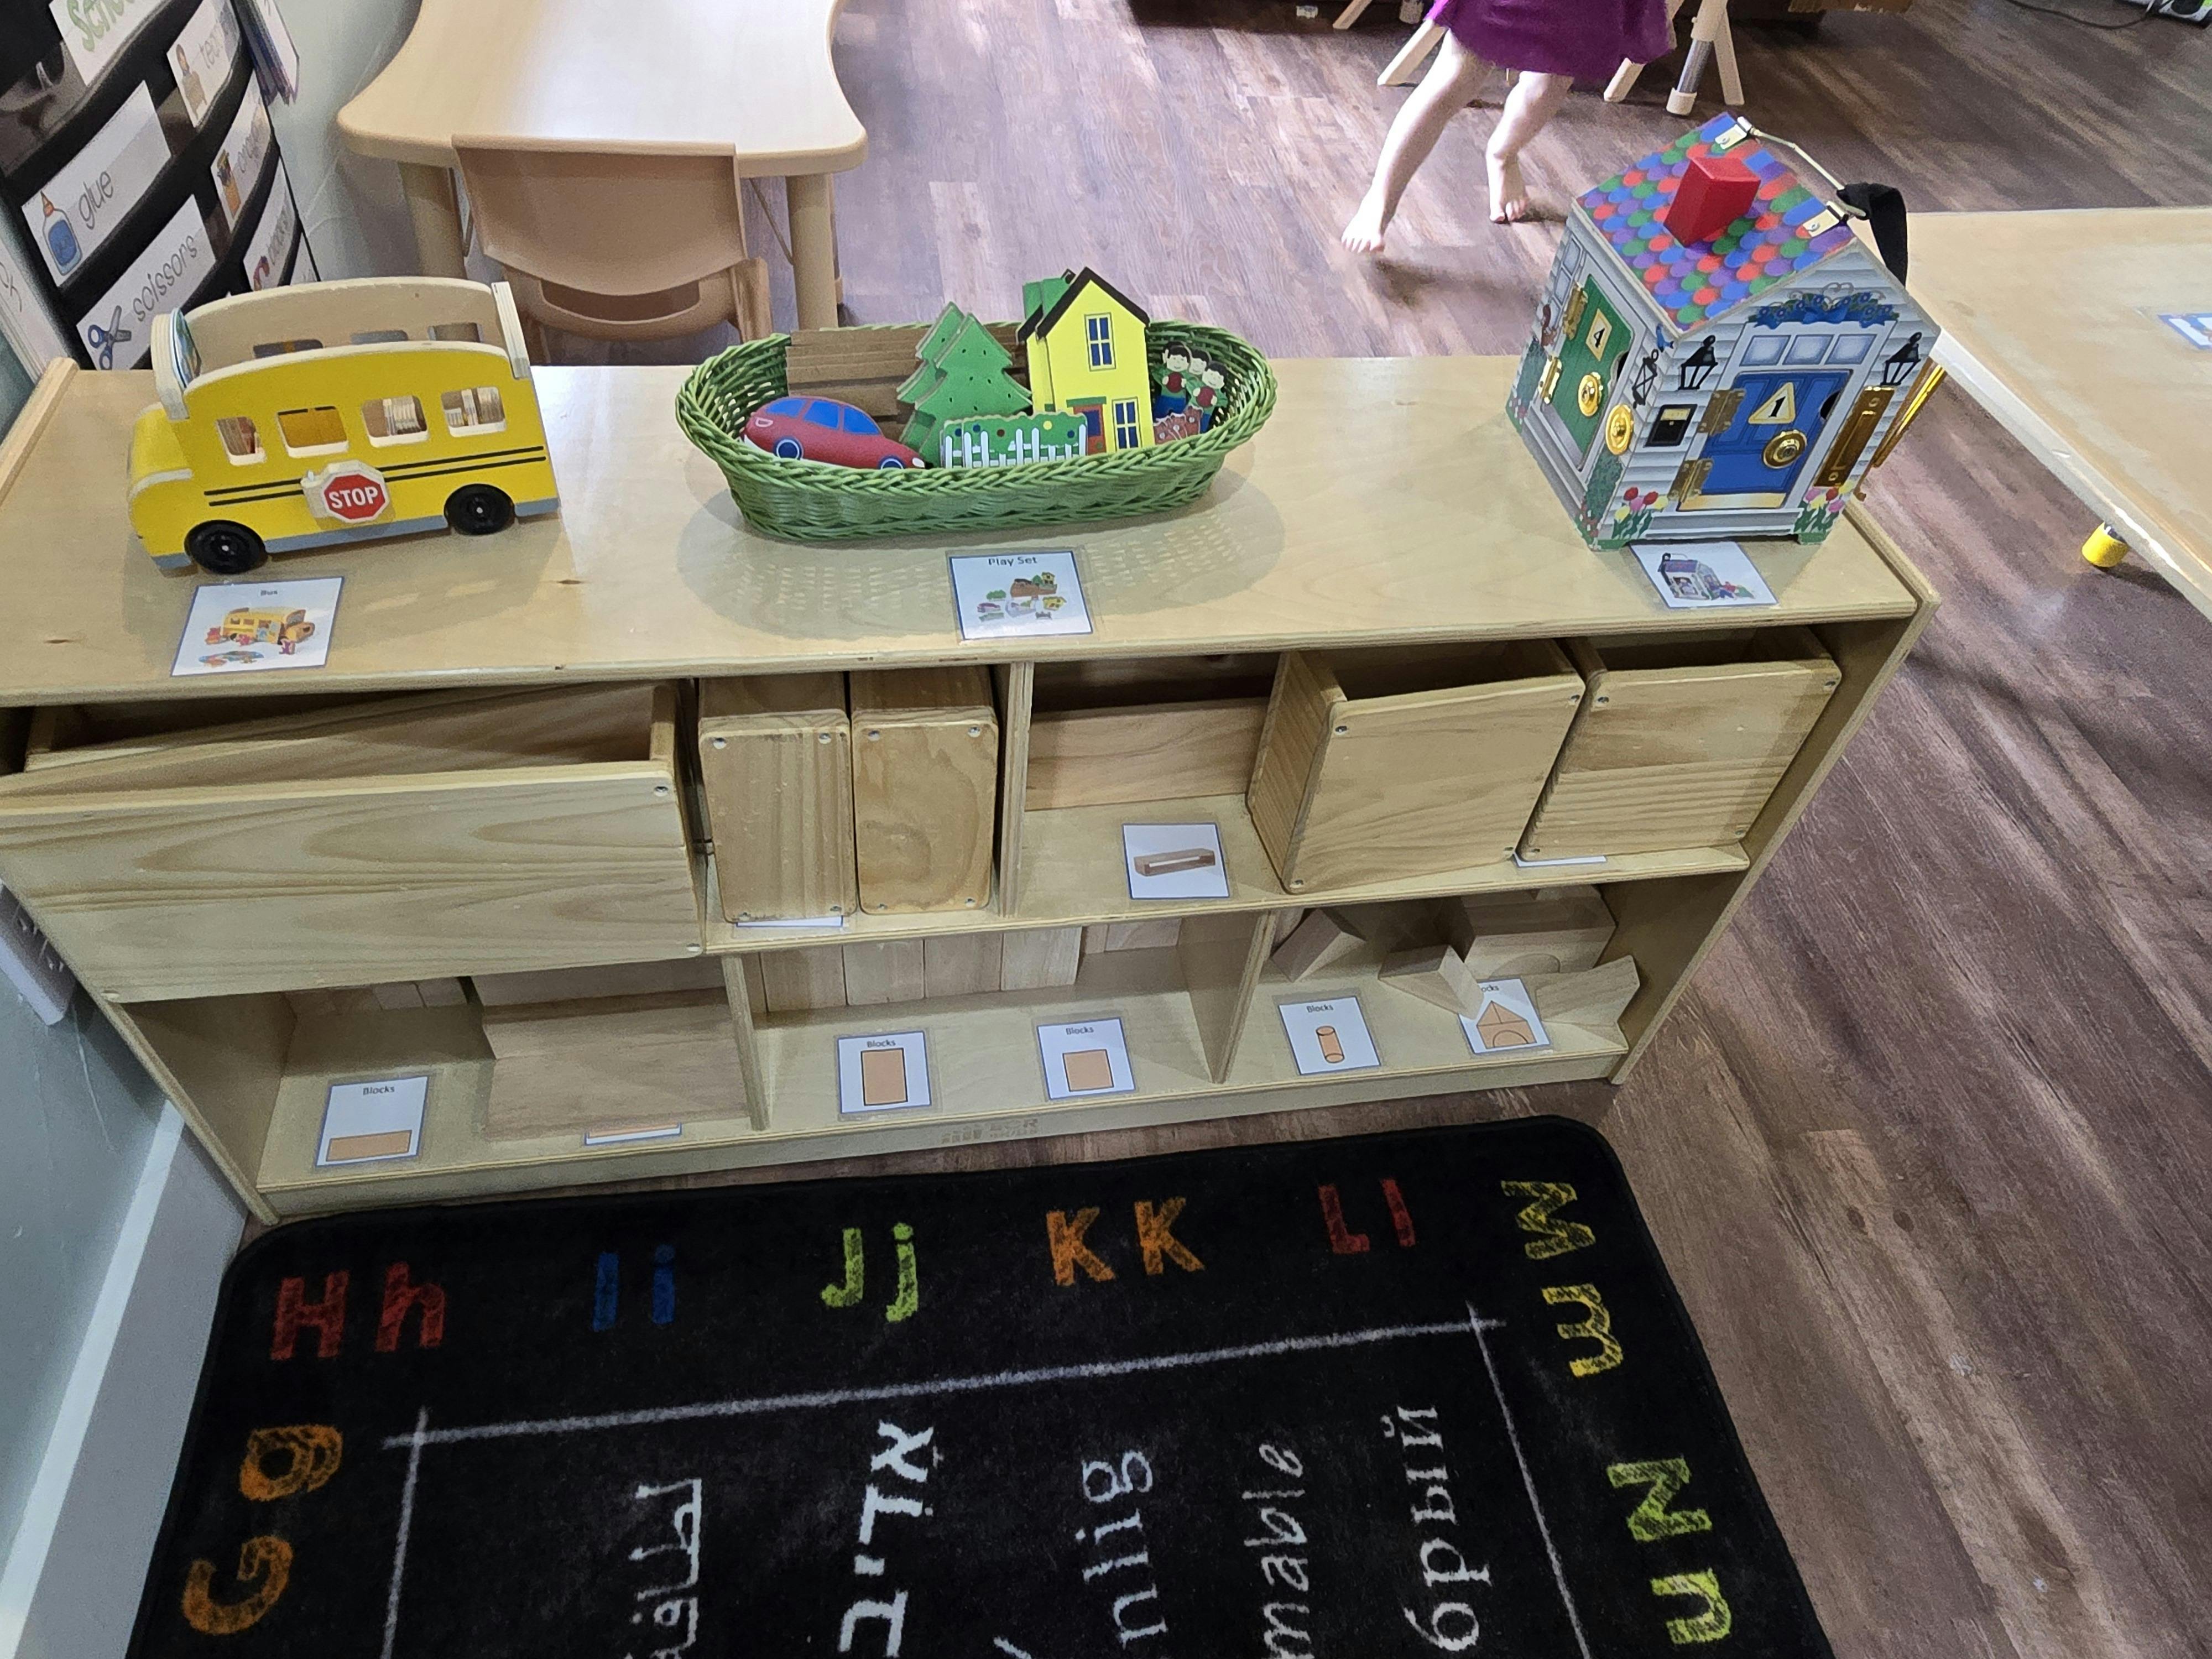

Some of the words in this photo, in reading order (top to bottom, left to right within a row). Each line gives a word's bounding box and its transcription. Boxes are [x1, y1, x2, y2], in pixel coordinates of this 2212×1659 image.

[79, 171, 114, 230] glue
[133, 235, 197, 322] scissors
[1593, 327, 1605, 348] 4
[1768, 396, 1786, 418] 1
[328, 486, 378, 509] STOP
[988, 557, 1014, 567] Play
[1017, 556, 1037, 565] Set
[1480, 984, 1500, 993] ocks
[1306, 1004, 1334, 1013] Blocks
[1065, 1026, 1094, 1035] Blocks
[867, 1040, 896, 1048] Blocks
[363, 1086, 395, 1095] Blocks
